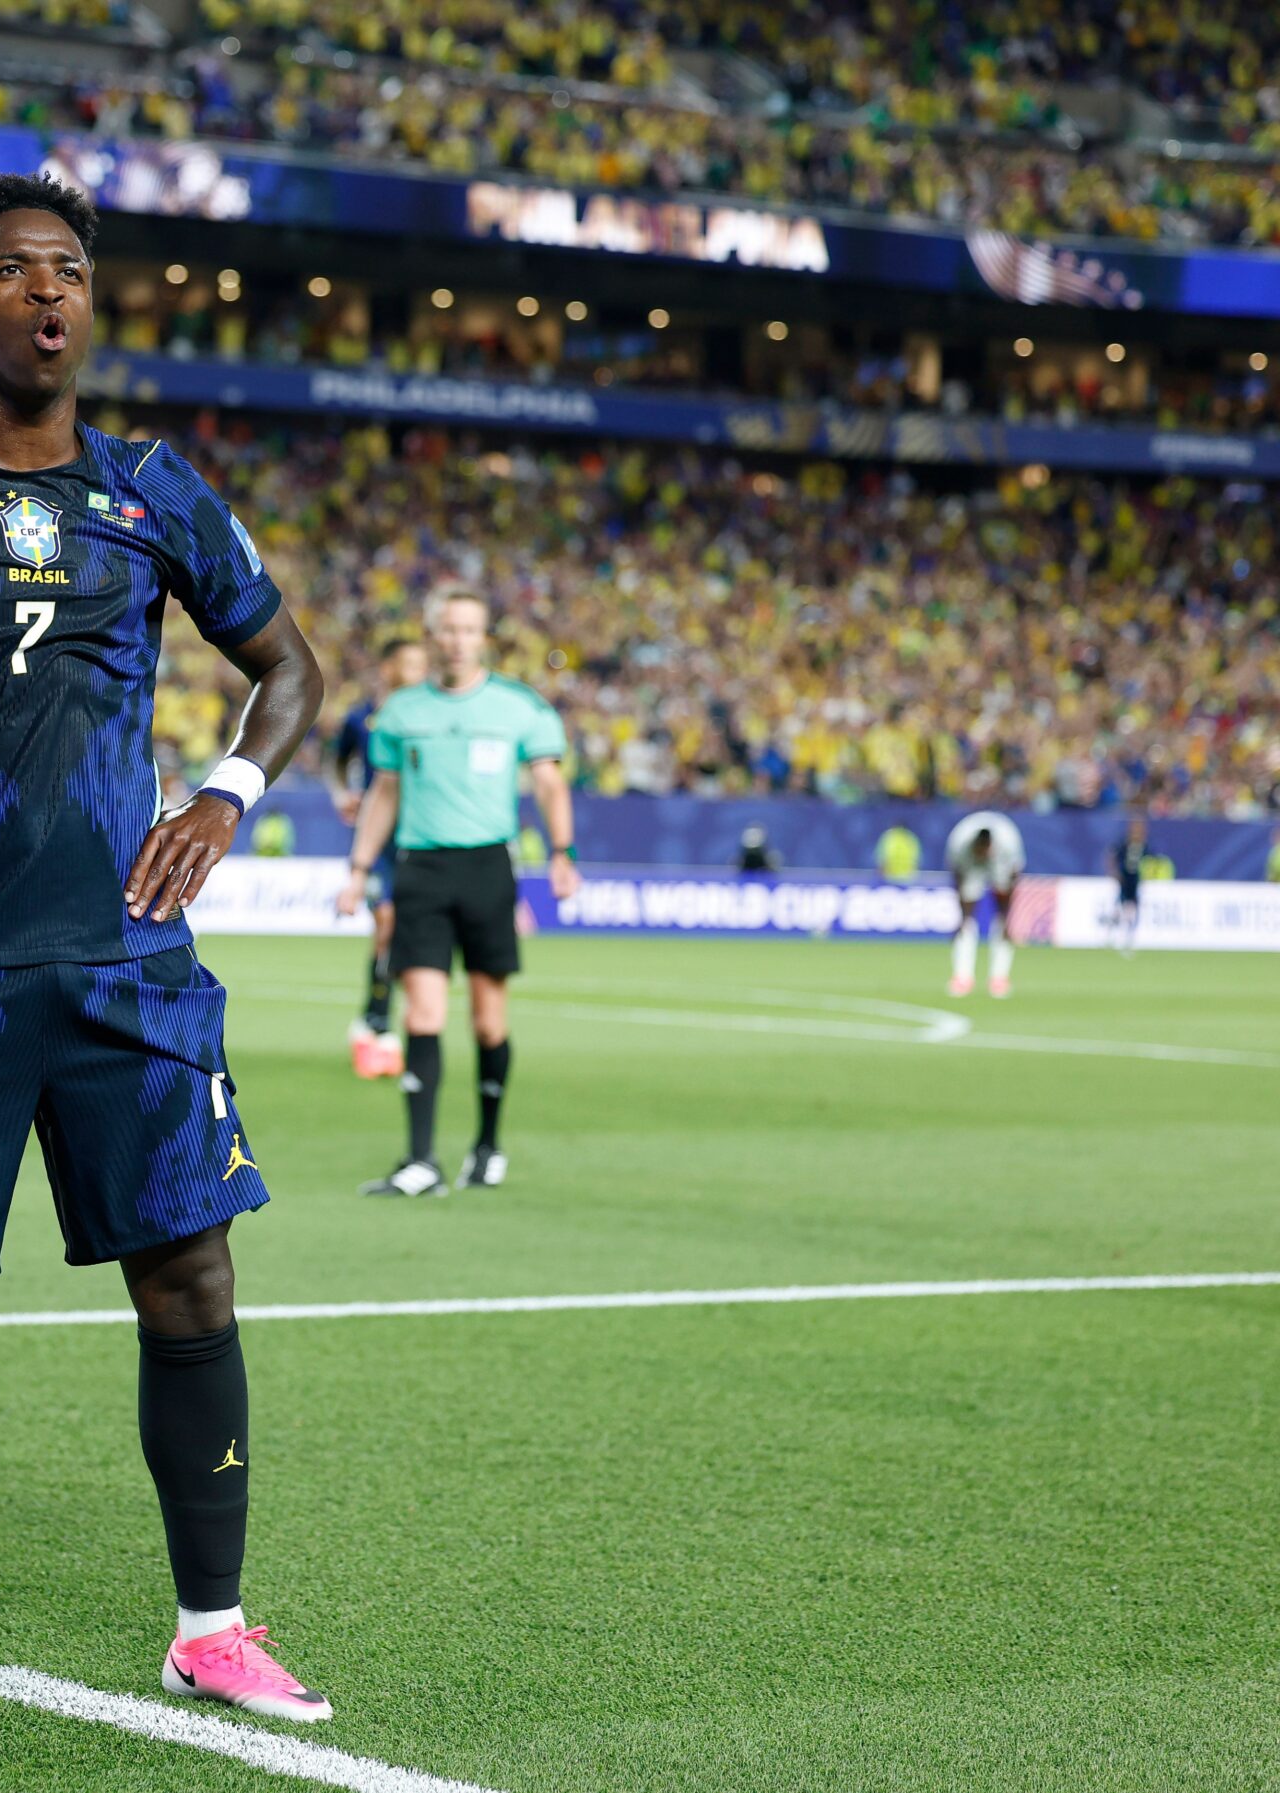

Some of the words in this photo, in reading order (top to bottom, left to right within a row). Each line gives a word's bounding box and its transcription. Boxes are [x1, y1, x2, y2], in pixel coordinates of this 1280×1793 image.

[20, 527, 42, 537] CBF
[8, 567, 70, 585] BRASIL
[11, 600, 56, 675] 7
